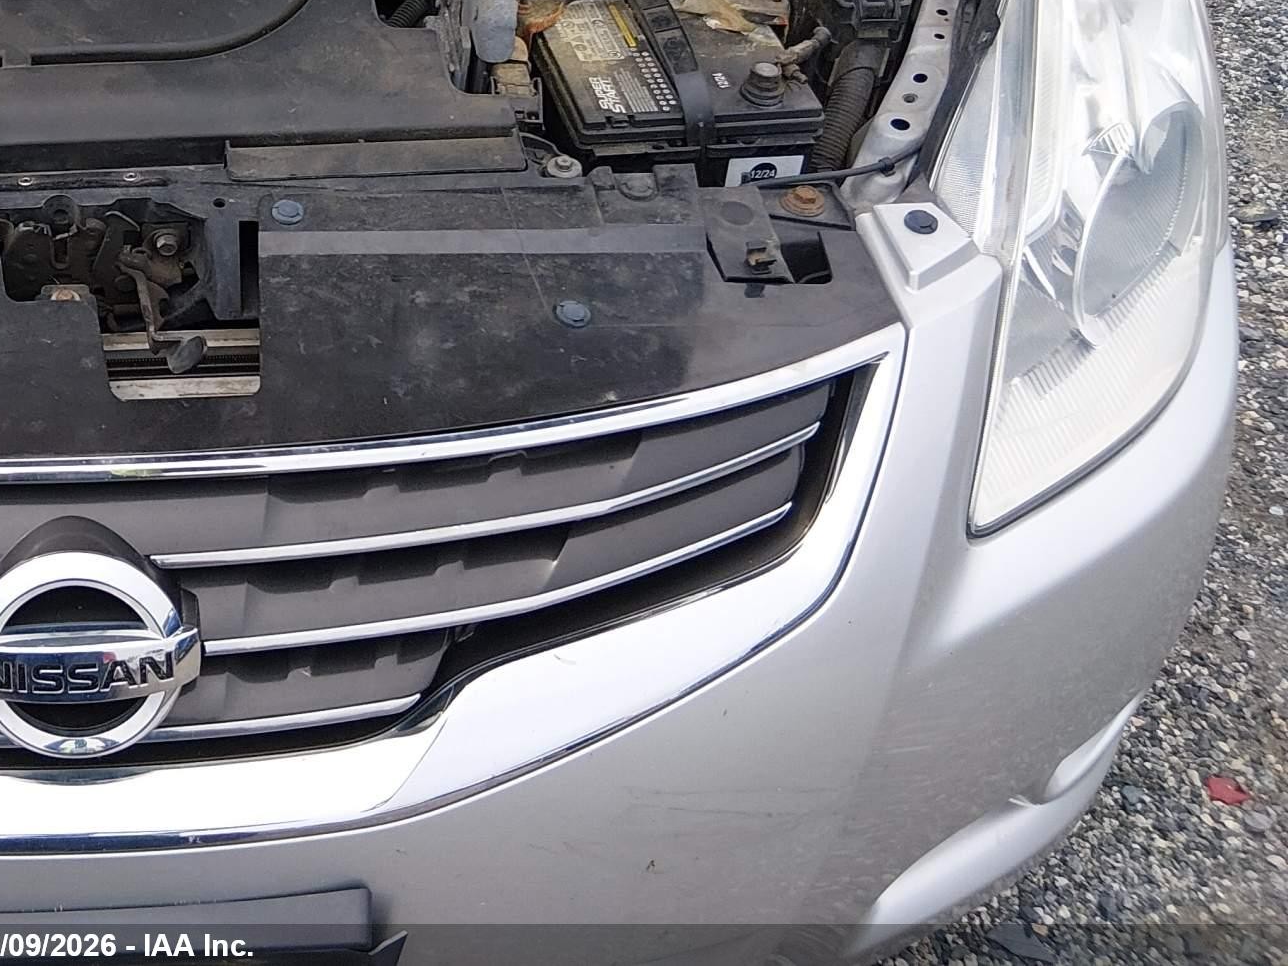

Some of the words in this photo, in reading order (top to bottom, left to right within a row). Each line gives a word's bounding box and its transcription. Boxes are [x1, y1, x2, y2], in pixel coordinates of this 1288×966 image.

[589, 77, 610, 109] SUPER
[601, 77, 627, 113] START
[751, 169, 776, 179] 12/24
